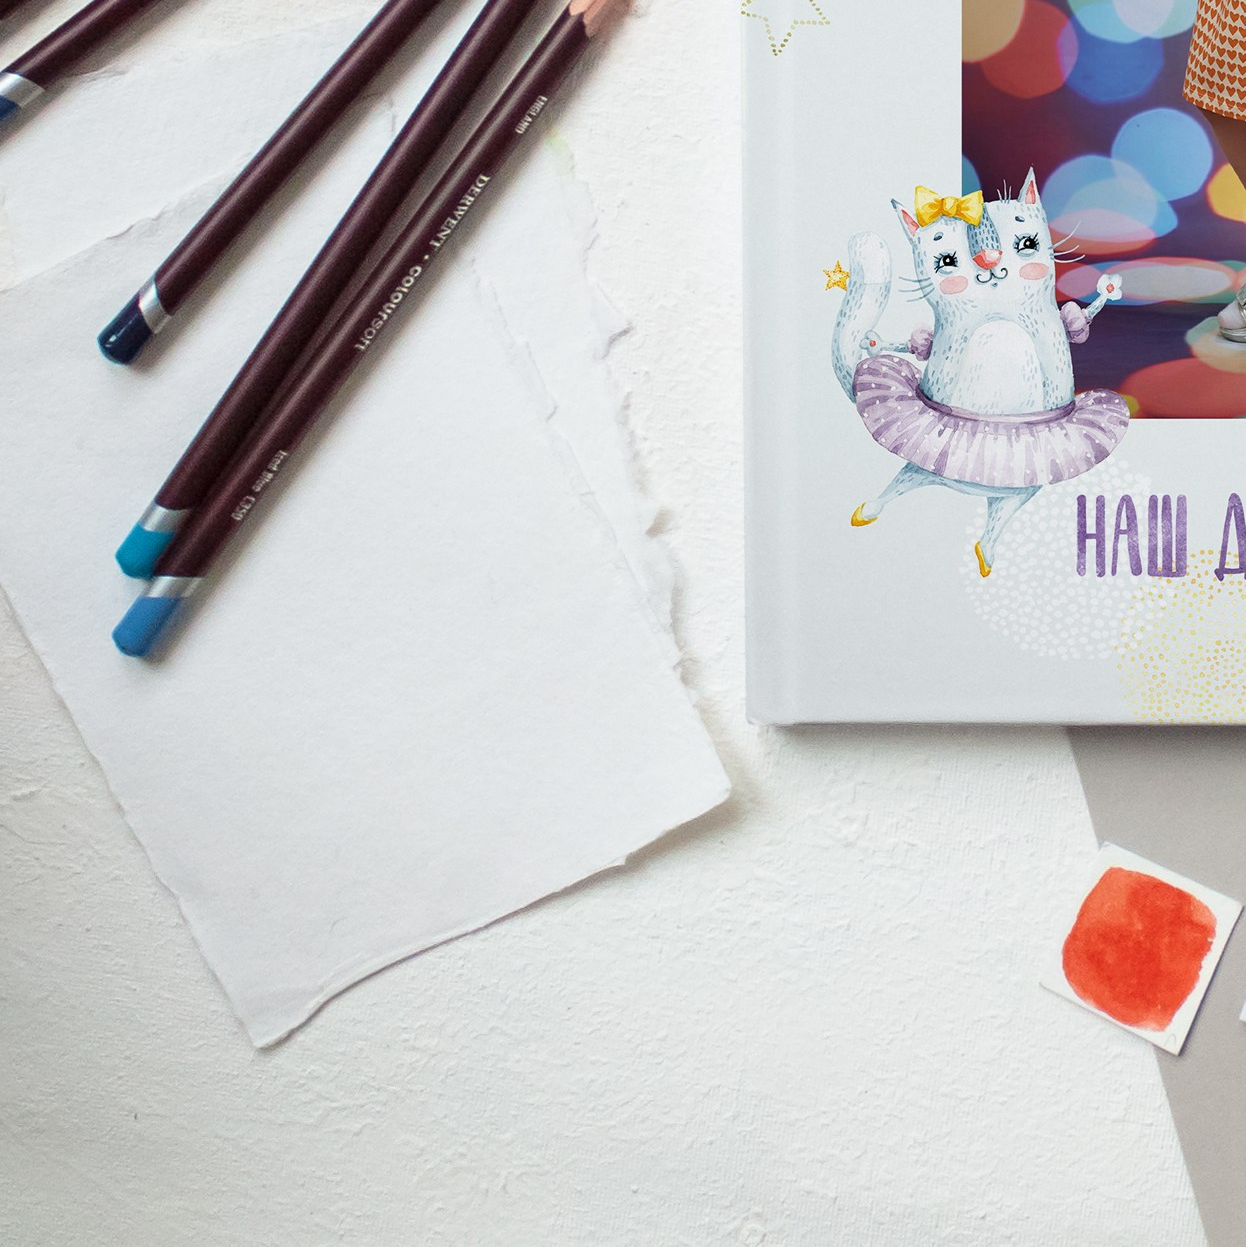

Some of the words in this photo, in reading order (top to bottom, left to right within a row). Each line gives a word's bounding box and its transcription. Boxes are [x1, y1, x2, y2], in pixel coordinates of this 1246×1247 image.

[514, 95, 548, 134] ENGLAND
[429, 173, 491, 251] DERWENT
[1076, 493, 1188, 578] НАШ
